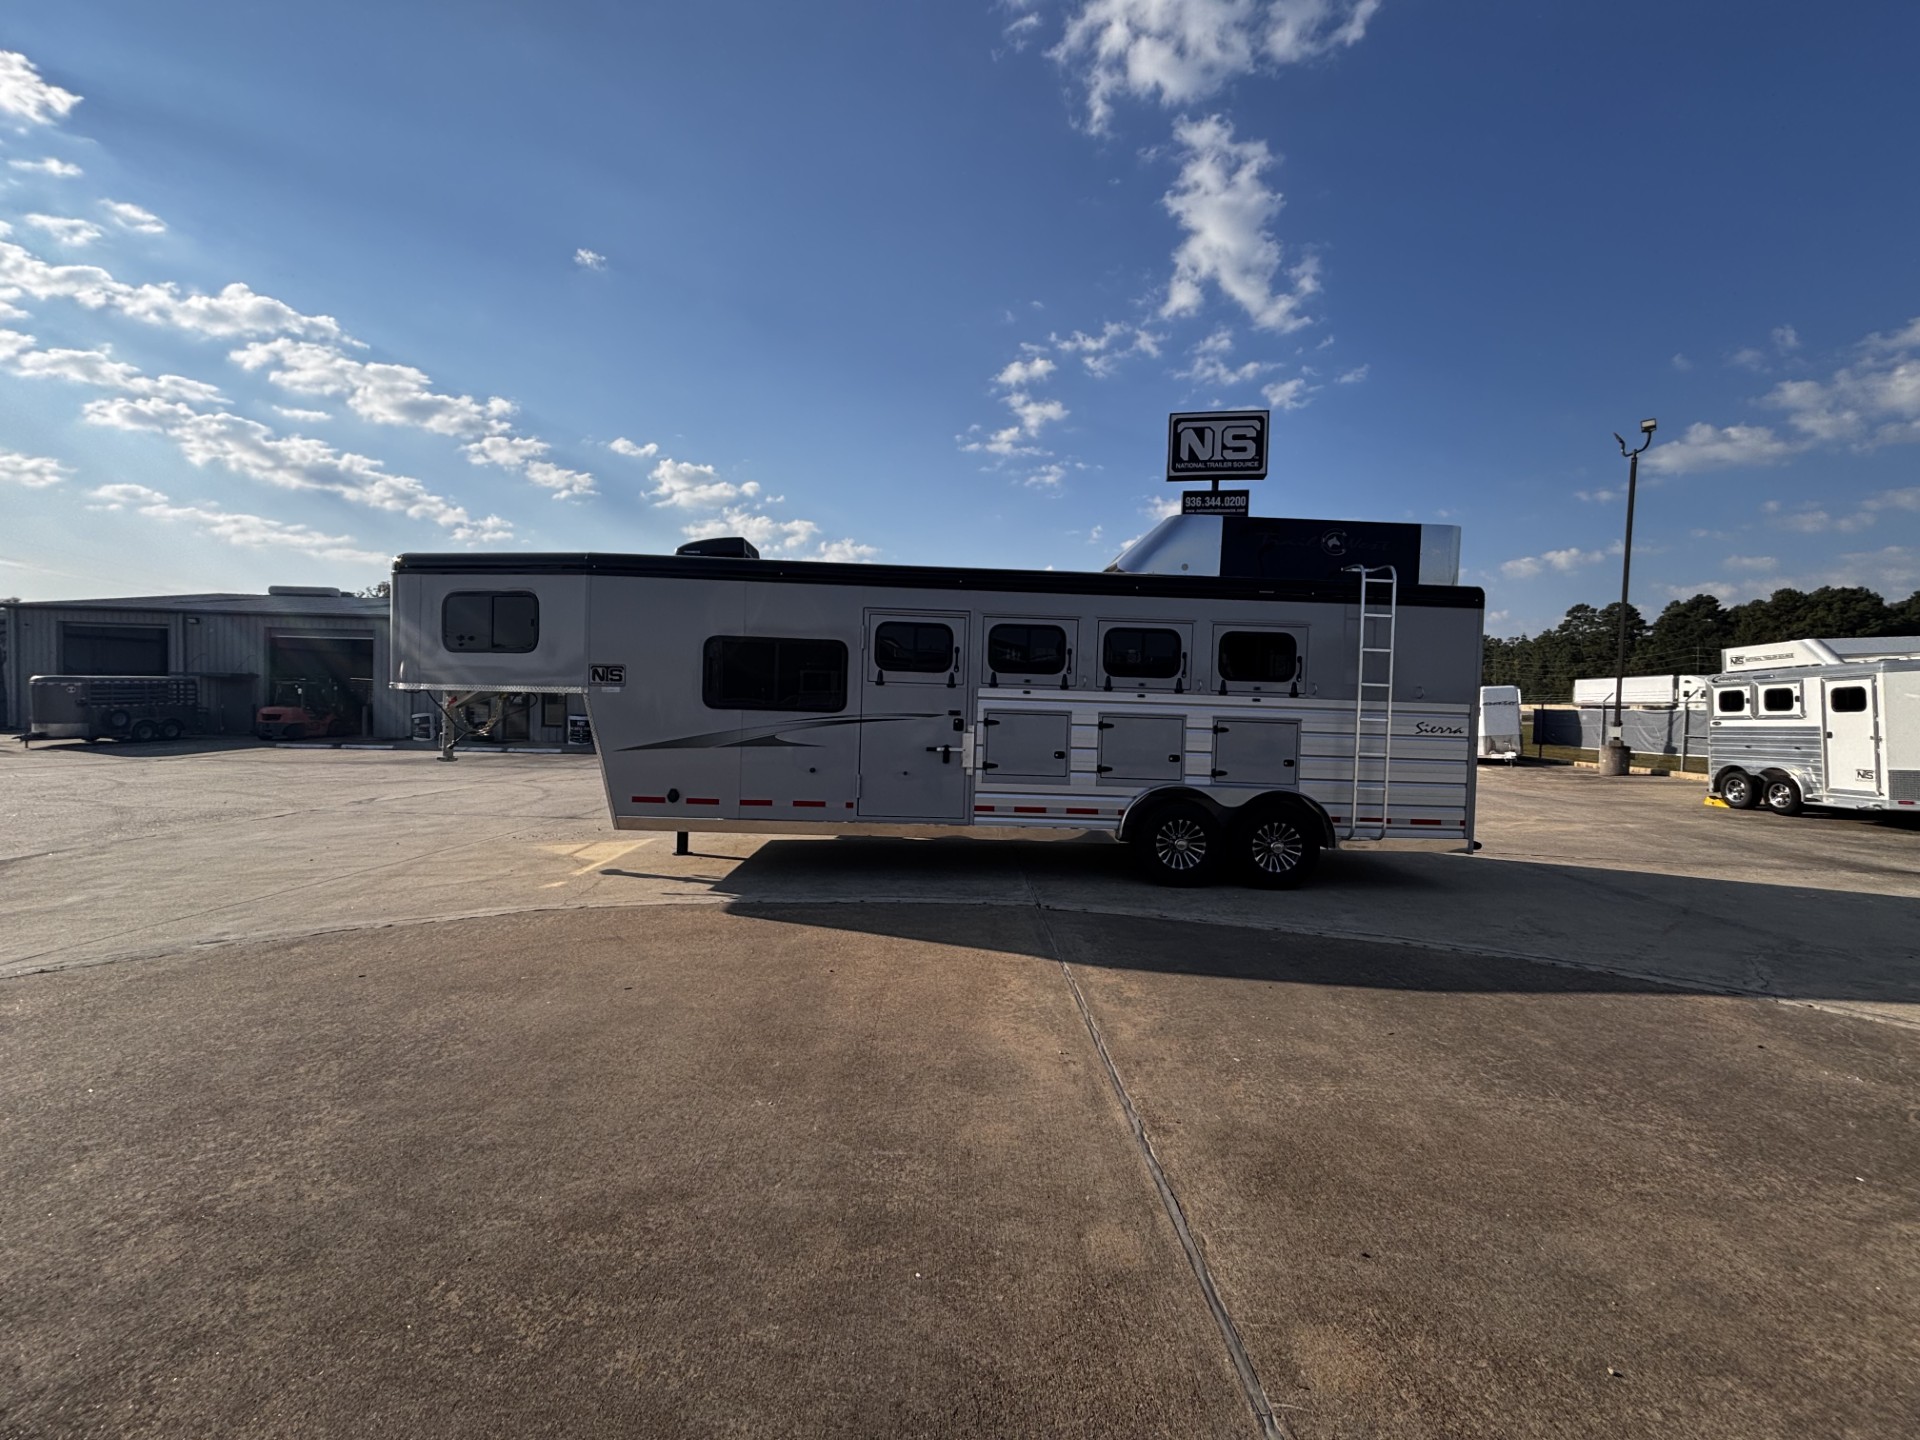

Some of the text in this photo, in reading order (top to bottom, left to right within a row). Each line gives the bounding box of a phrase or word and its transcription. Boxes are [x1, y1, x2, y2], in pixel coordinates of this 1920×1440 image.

[1177, 420, 1261, 461] NTS
[1185, 496, 1247, 507] 936.344.0200
[590, 665, 624, 682] NTS
[1415, 721, 1464, 735] Sierra
